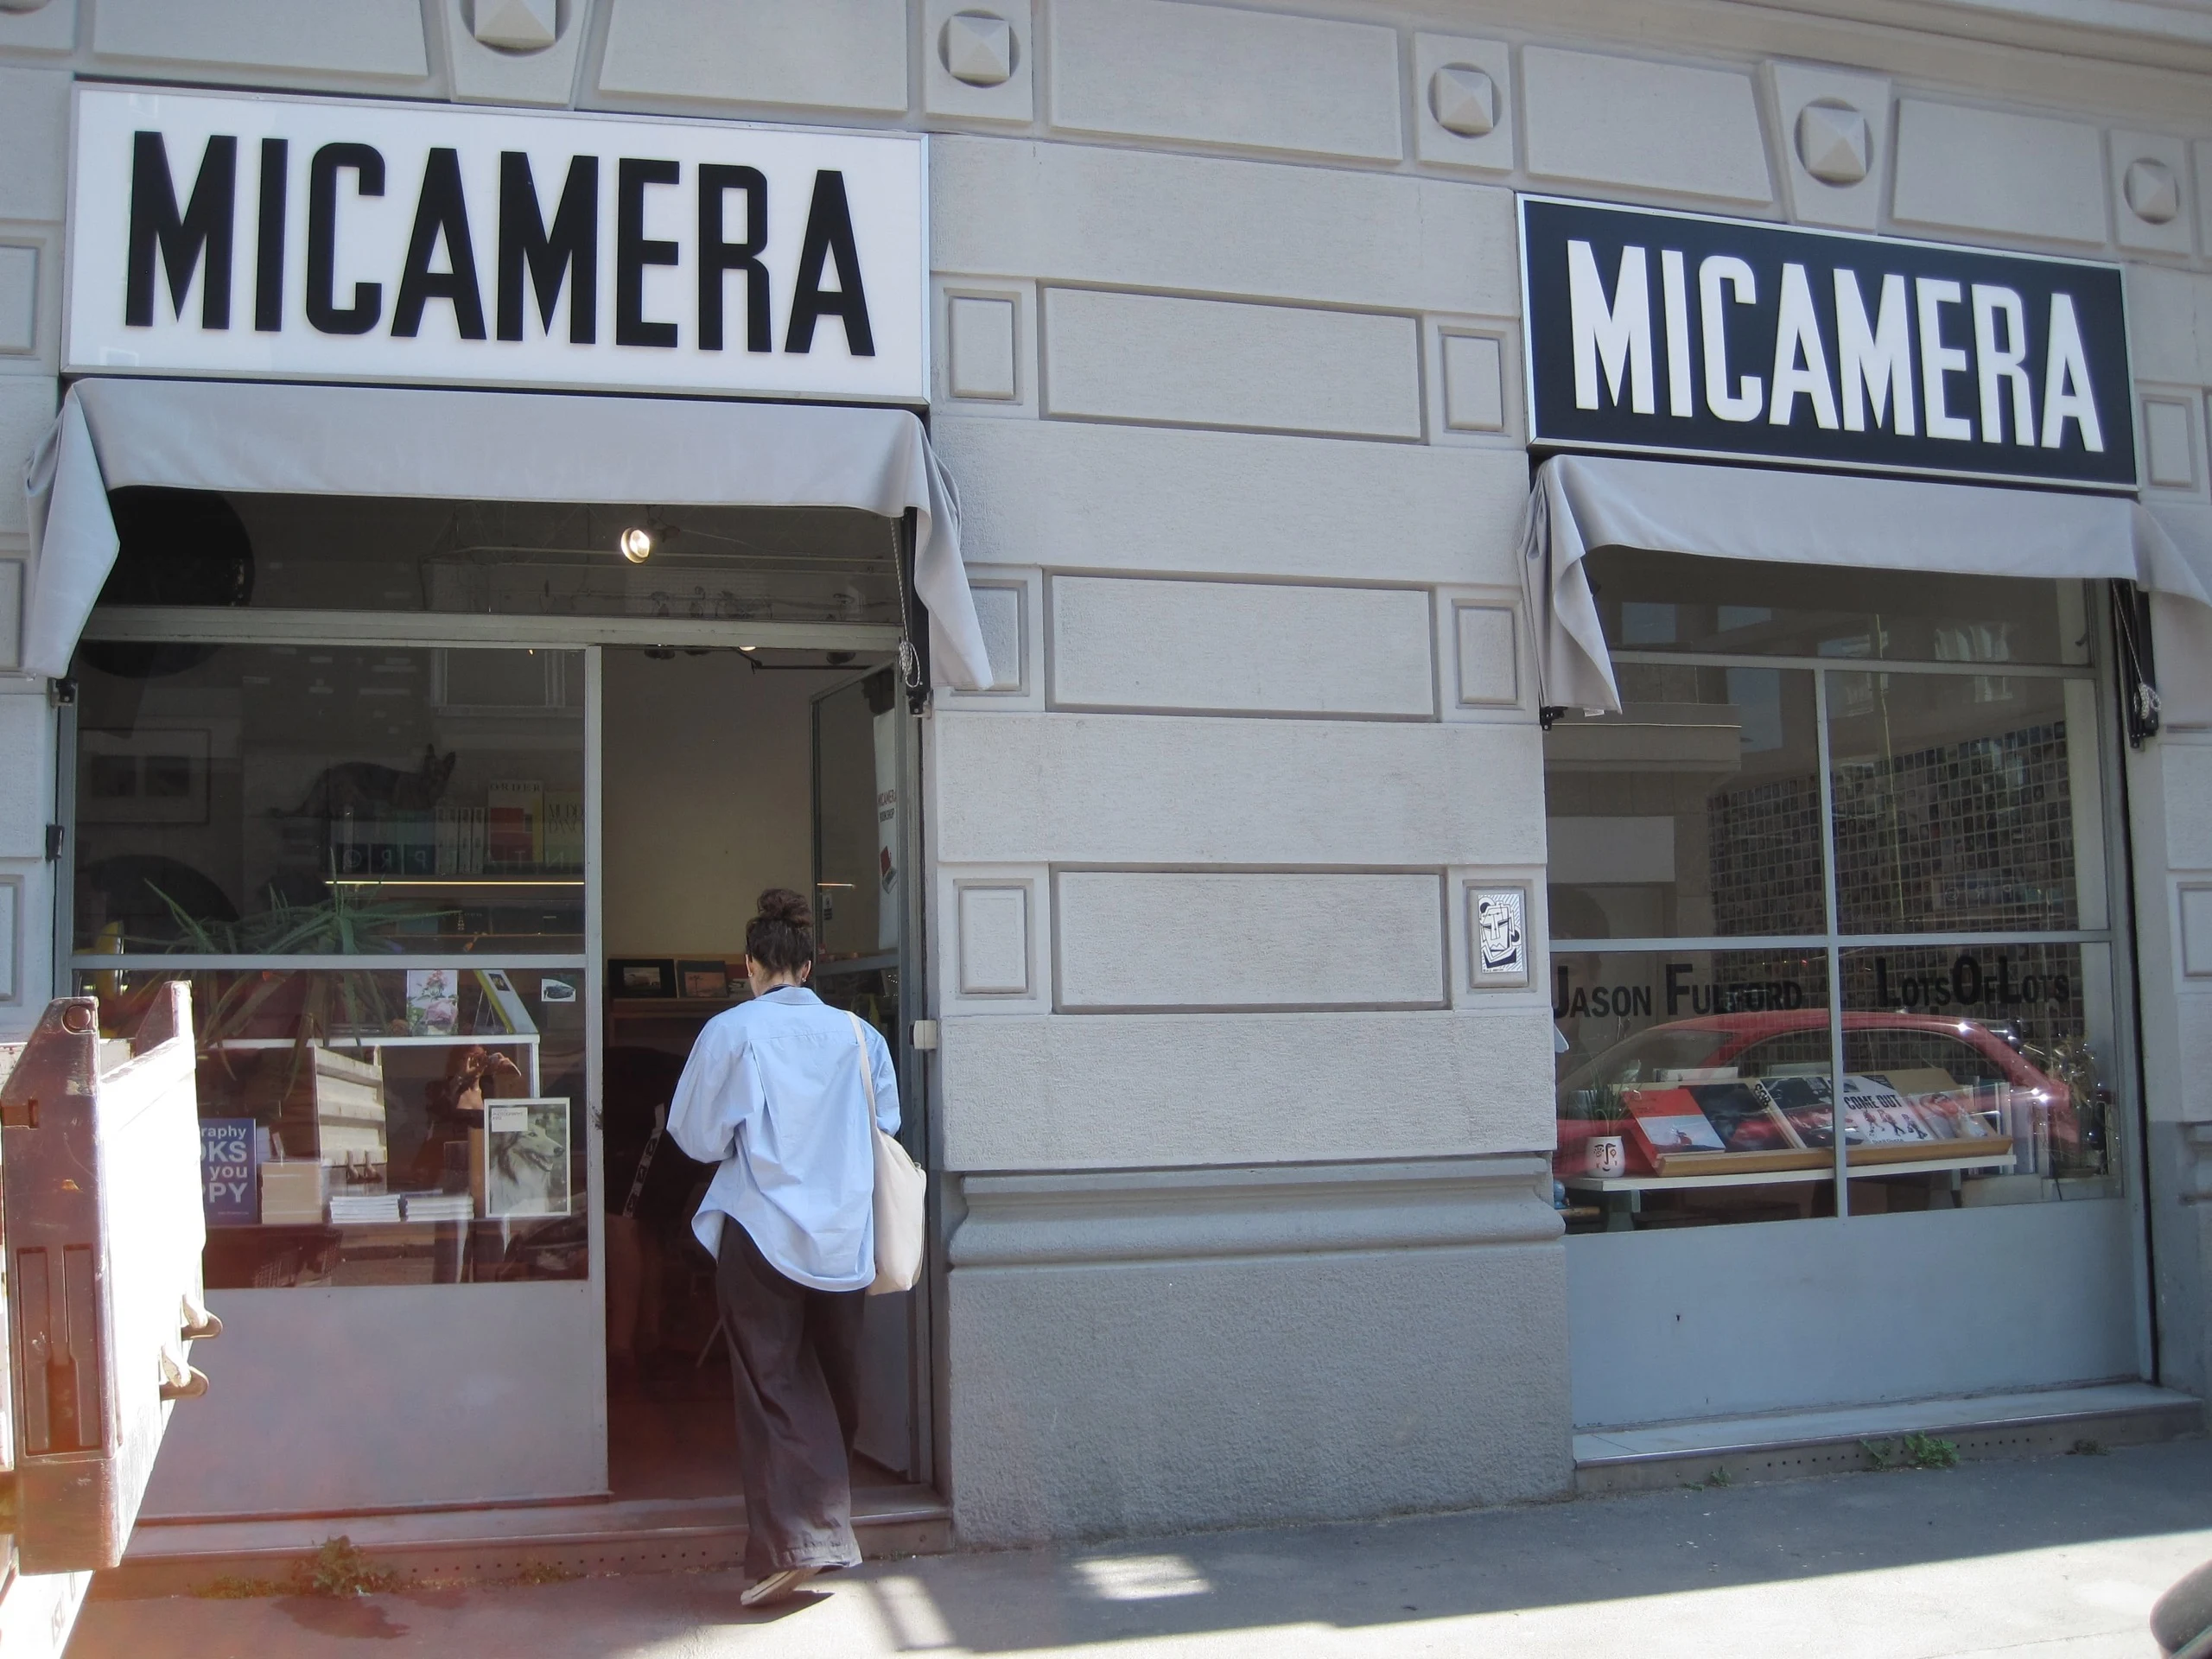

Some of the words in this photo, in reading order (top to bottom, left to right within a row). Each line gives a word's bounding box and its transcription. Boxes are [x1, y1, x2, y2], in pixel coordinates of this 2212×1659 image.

[125, 131, 875, 357] MICAMERA
[1567, 239, 2104, 453] MICAMERA
[490, 783, 540, 792] ORDER
[1554, 965, 1651, 1019] JASON
[1666, 963, 1802, 1015] FULFORD
[1843, 1095, 1879, 1110] COME
[1876, 1093, 1903, 1109] OUT
[209, 1166, 248, 1181] you
[202, 1182, 248, 1204] PY
